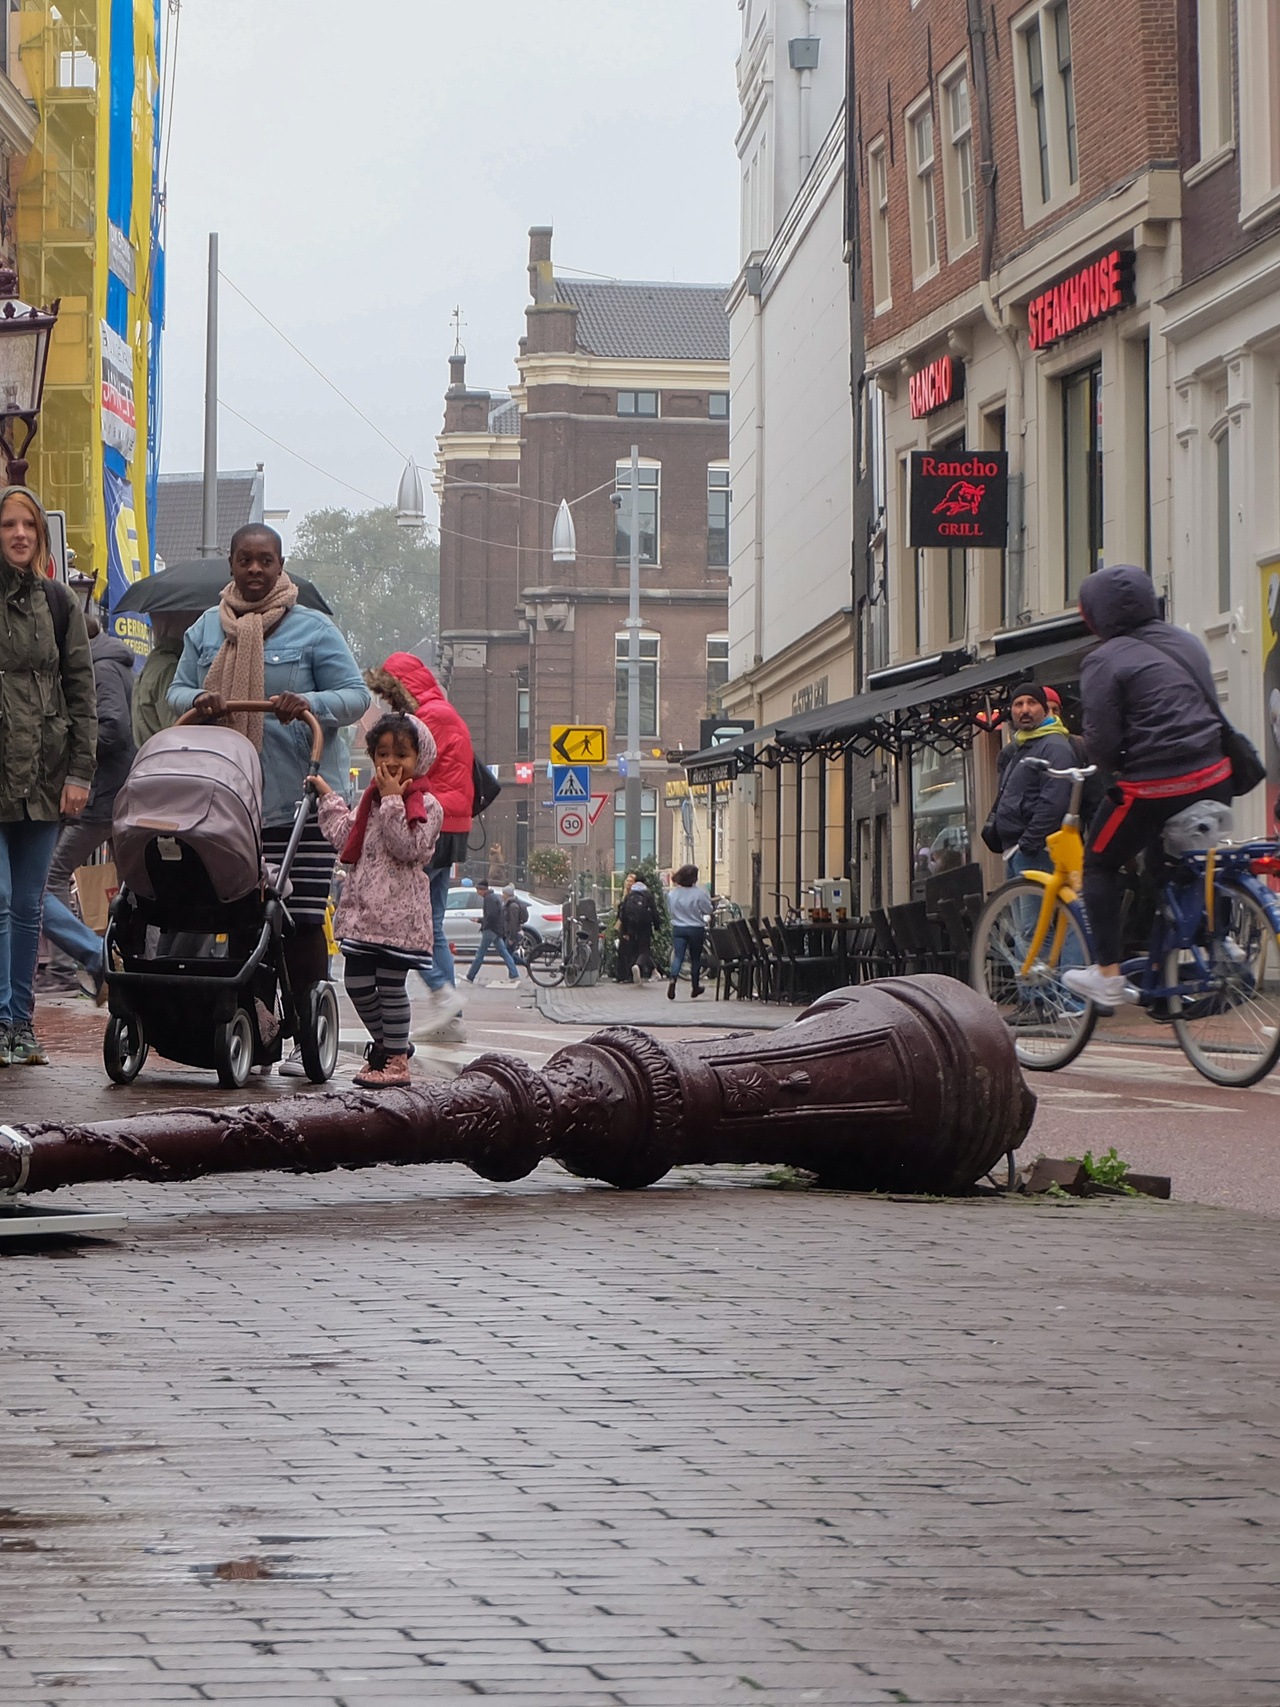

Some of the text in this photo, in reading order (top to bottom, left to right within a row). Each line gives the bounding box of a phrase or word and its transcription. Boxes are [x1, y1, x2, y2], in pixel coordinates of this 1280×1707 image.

[1028, 250, 1121, 351] STEAKHOUSE
[909, 354, 952, 420] RANCHO
[921, 457, 999, 477] Rancho
[938, 523, 984, 535] GRILL
[564, 819, 580, 829] 30
